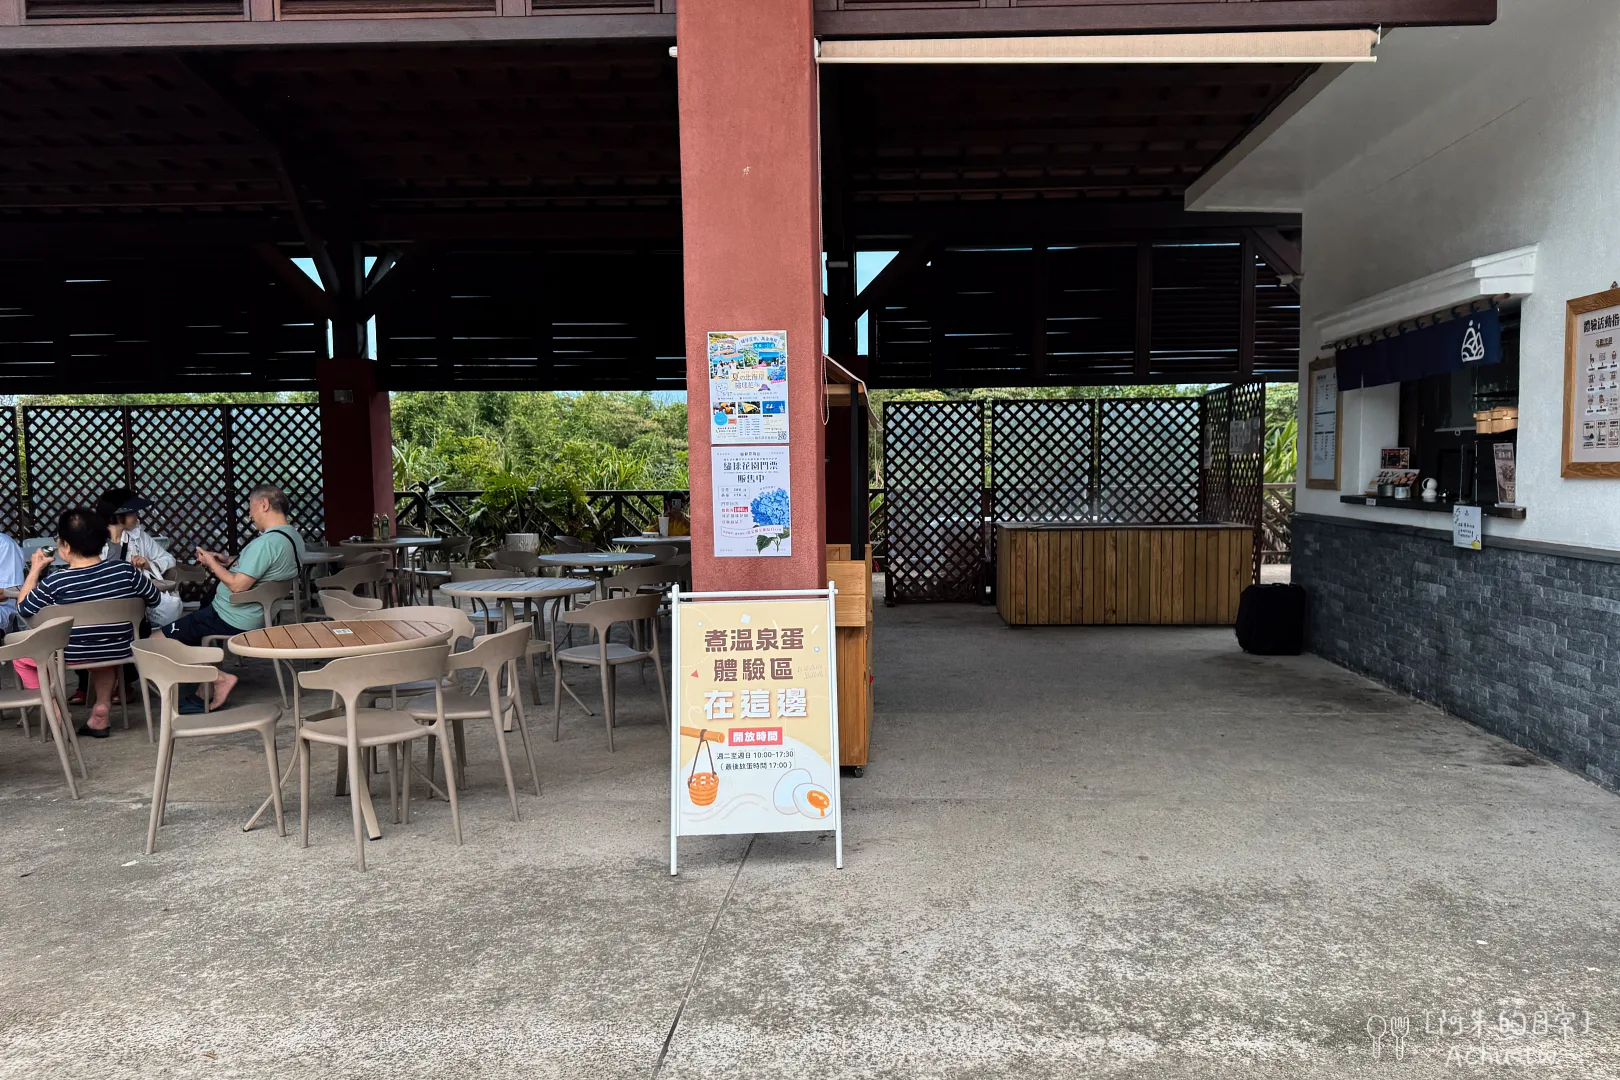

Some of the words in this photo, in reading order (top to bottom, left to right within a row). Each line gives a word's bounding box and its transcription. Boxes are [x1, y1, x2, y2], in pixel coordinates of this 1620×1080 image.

[704, 627, 804, 653] 煮溫泉蛋
[713, 657, 794, 682] 體驗區
[703, 687, 808, 720] 在這邊
[732, 730, 778, 743] 開放時間
[716, 751, 751, 760] 週二至週日
[753, 750, 794, 759] 10:00-17:30
